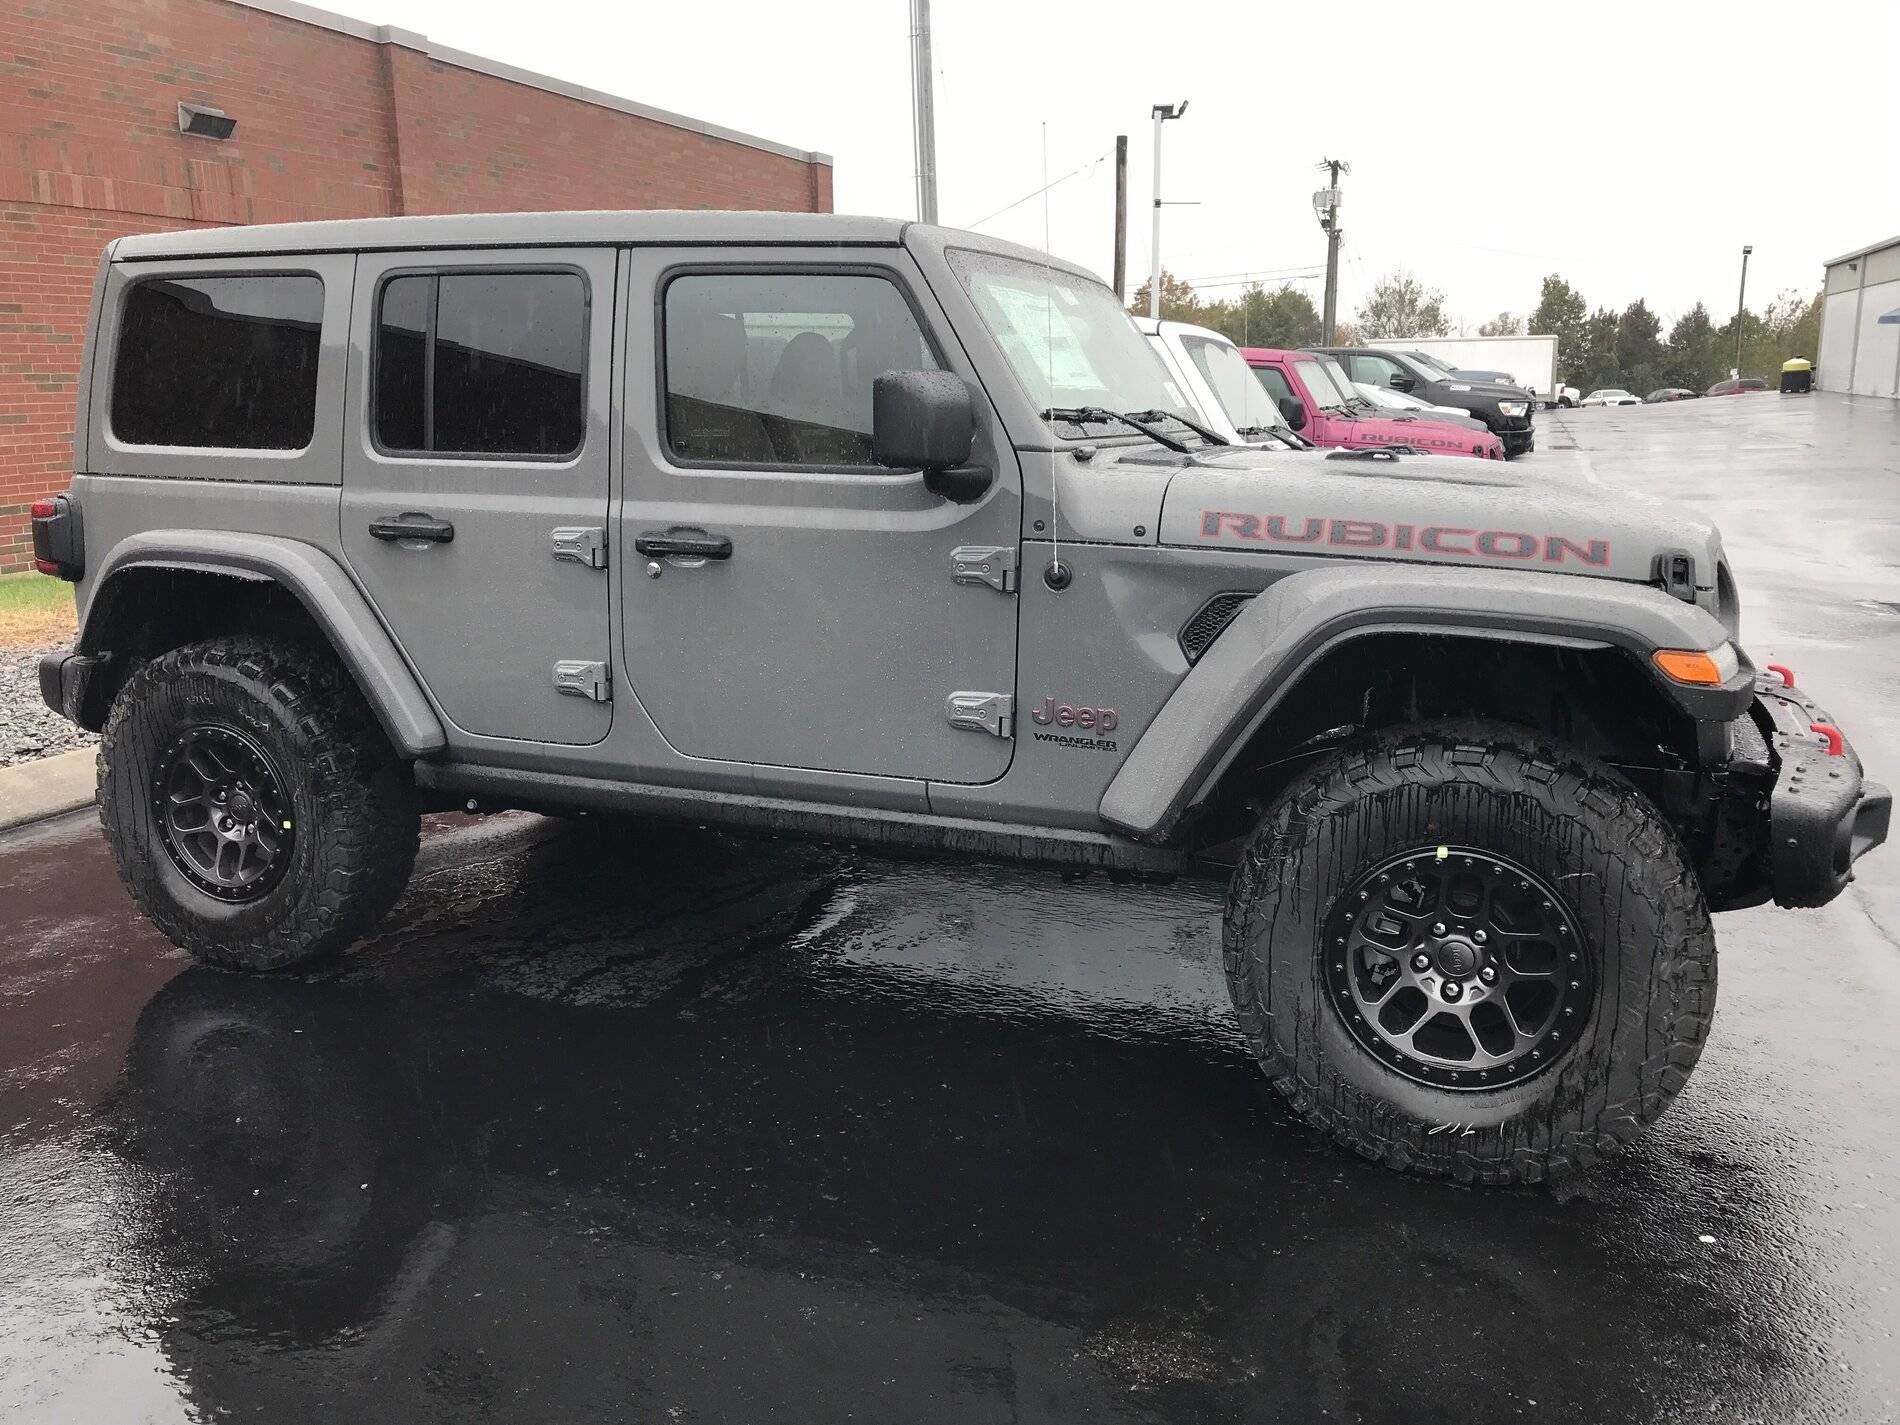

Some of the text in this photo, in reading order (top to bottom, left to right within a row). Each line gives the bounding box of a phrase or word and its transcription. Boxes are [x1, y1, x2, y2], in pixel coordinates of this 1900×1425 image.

[1360, 433, 1463, 449] RUBICON
[1200, 510, 1611, 567] RUBICON
[1031, 696, 1118, 736] Jeep
[1033, 732, 1117, 748] WRANGLER
[1059, 742, 1117, 753] UNLIMITED
